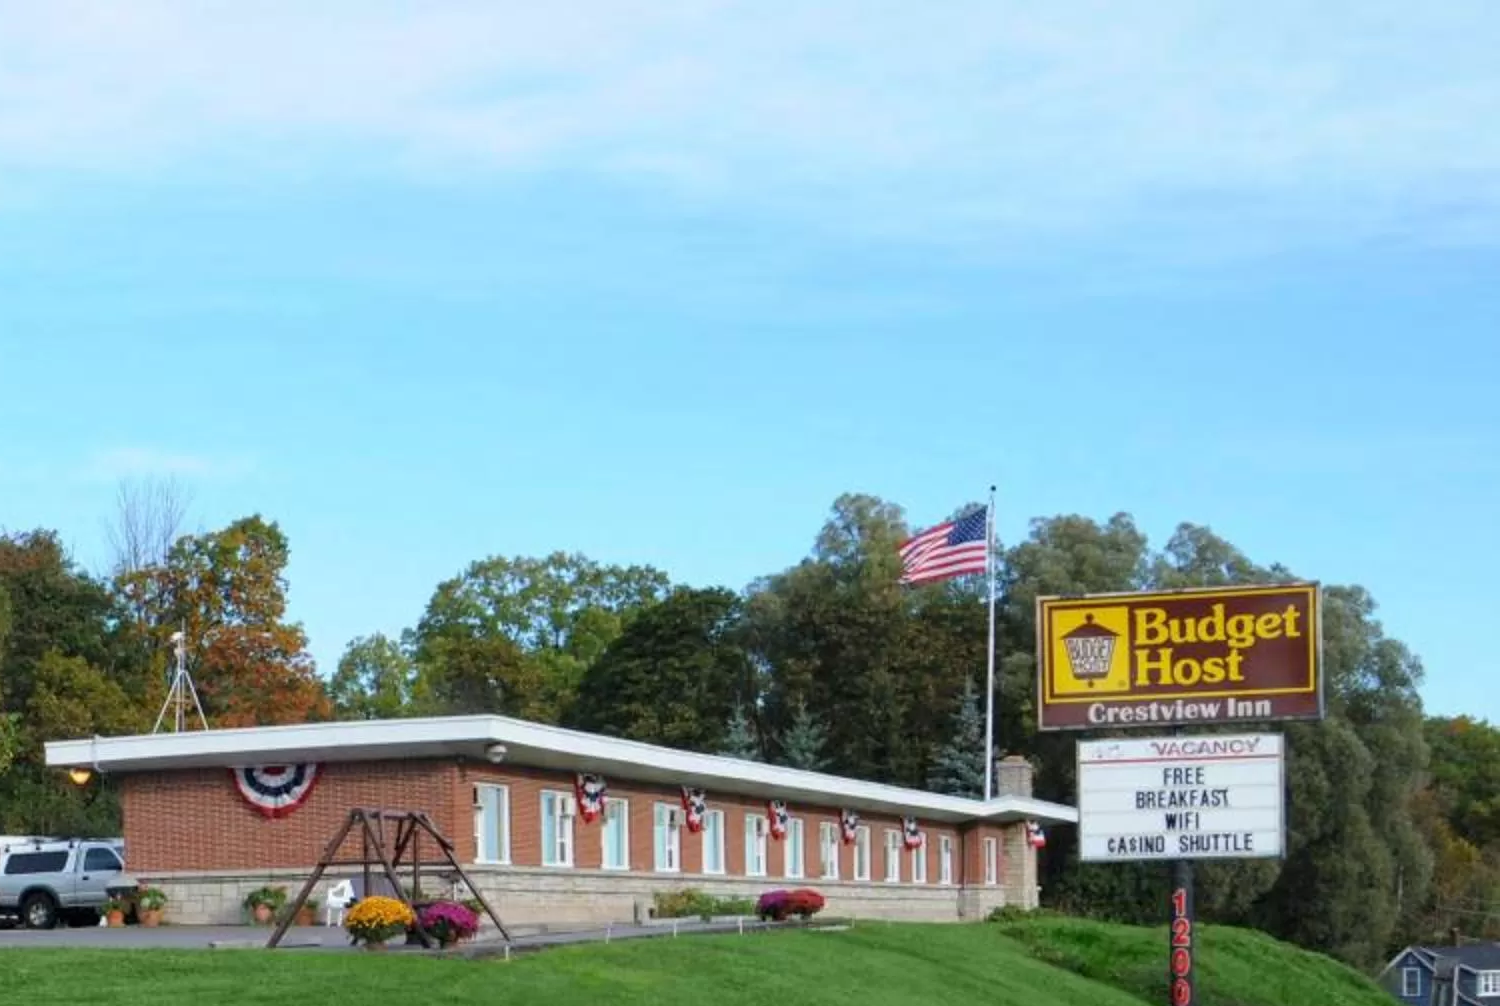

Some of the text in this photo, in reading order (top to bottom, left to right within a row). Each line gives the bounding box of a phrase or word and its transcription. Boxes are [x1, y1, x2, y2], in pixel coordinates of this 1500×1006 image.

[1133, 602, 1301, 648] Budget
[1134, 646, 1245, 687] Host
[1087, 697, 1272, 724] Crestview Inn
[1150, 736, 1261, 757] VACANCY
[1163, 766, 1205, 786] FREE
[1135, 788, 1230, 809] BREAKFAST
[1164, 811, 1201, 831] WIFI
[1107, 833, 1253, 853] CASINO SHUTTLE
